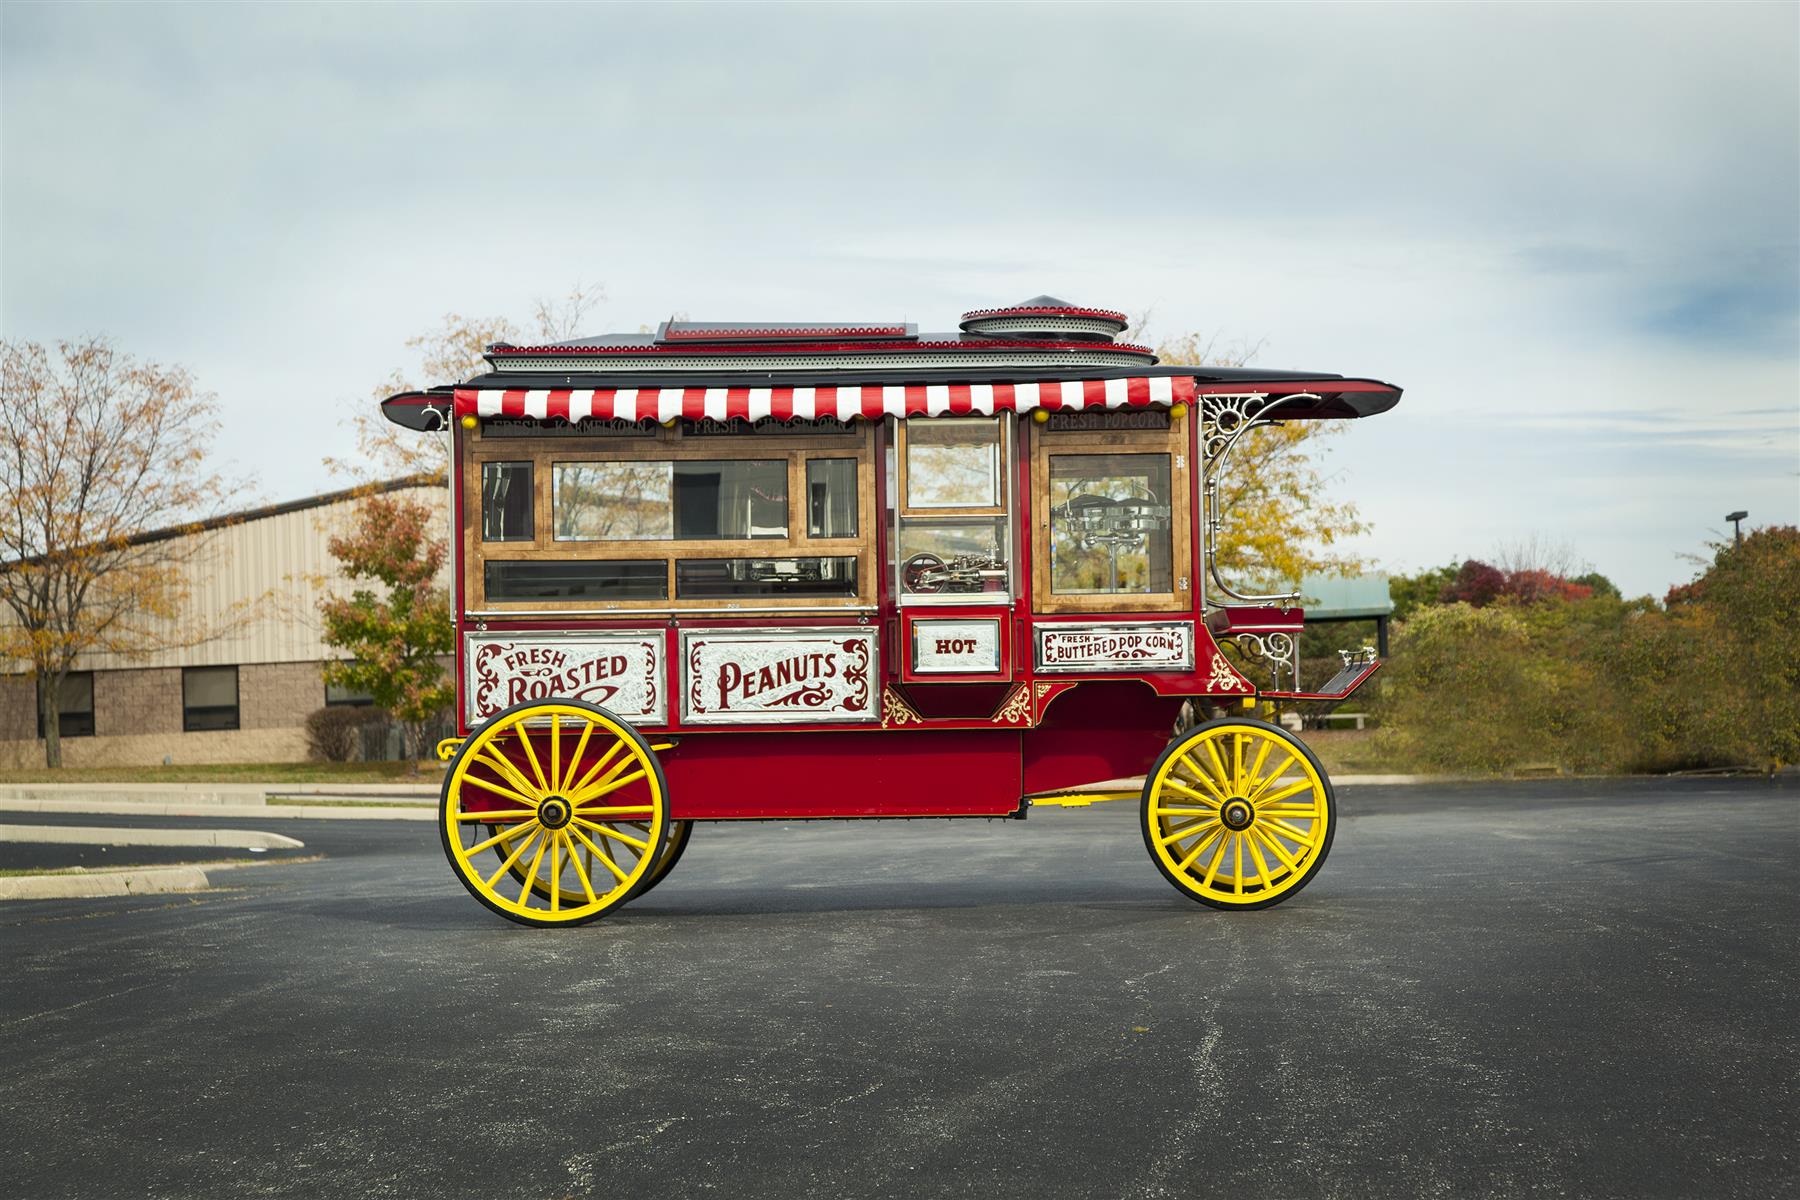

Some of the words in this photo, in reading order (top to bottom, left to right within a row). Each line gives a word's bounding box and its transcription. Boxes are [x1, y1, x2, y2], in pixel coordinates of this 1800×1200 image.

[493, 420, 541, 435] FRESH
[554, 419, 646, 434] KARMELKORN
[694, 420, 738, 433] FRESH
[1050, 413, 1097, 429] FRESH
[1104, 412, 1167, 428] POPCORN
[935, 639, 976, 654] HOT
[1057, 639, 1117, 659] BUTTERED
[1119, 636, 1142, 649] POP
[1146, 636, 1174, 650] CORN
[504, 649, 567, 671] FRESH
[507, 655, 628, 706] ROASTED
[717, 653, 836, 709] PEANUTS
